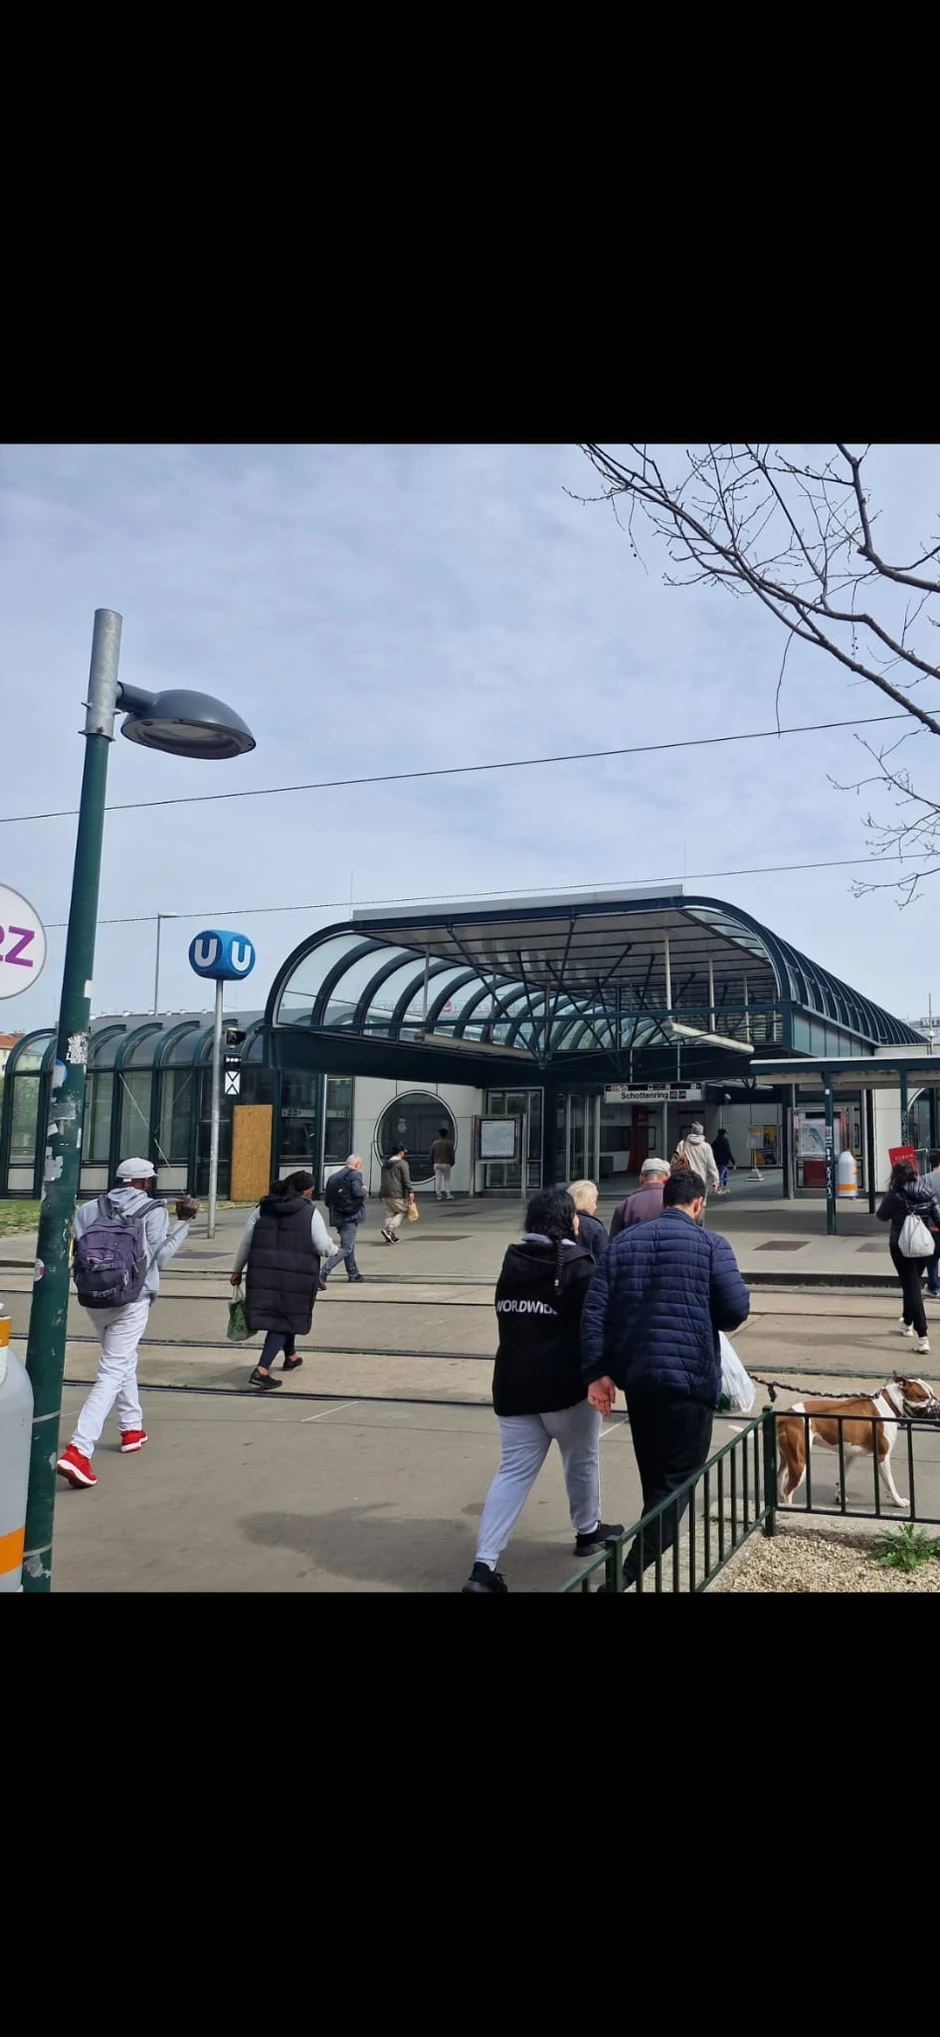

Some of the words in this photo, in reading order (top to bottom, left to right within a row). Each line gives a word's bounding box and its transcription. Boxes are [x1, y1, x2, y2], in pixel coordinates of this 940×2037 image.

[194, 938, 218, 967] U
[231, 940, 252, 971] U
[621, 1091, 669, 1100] Schottenring
